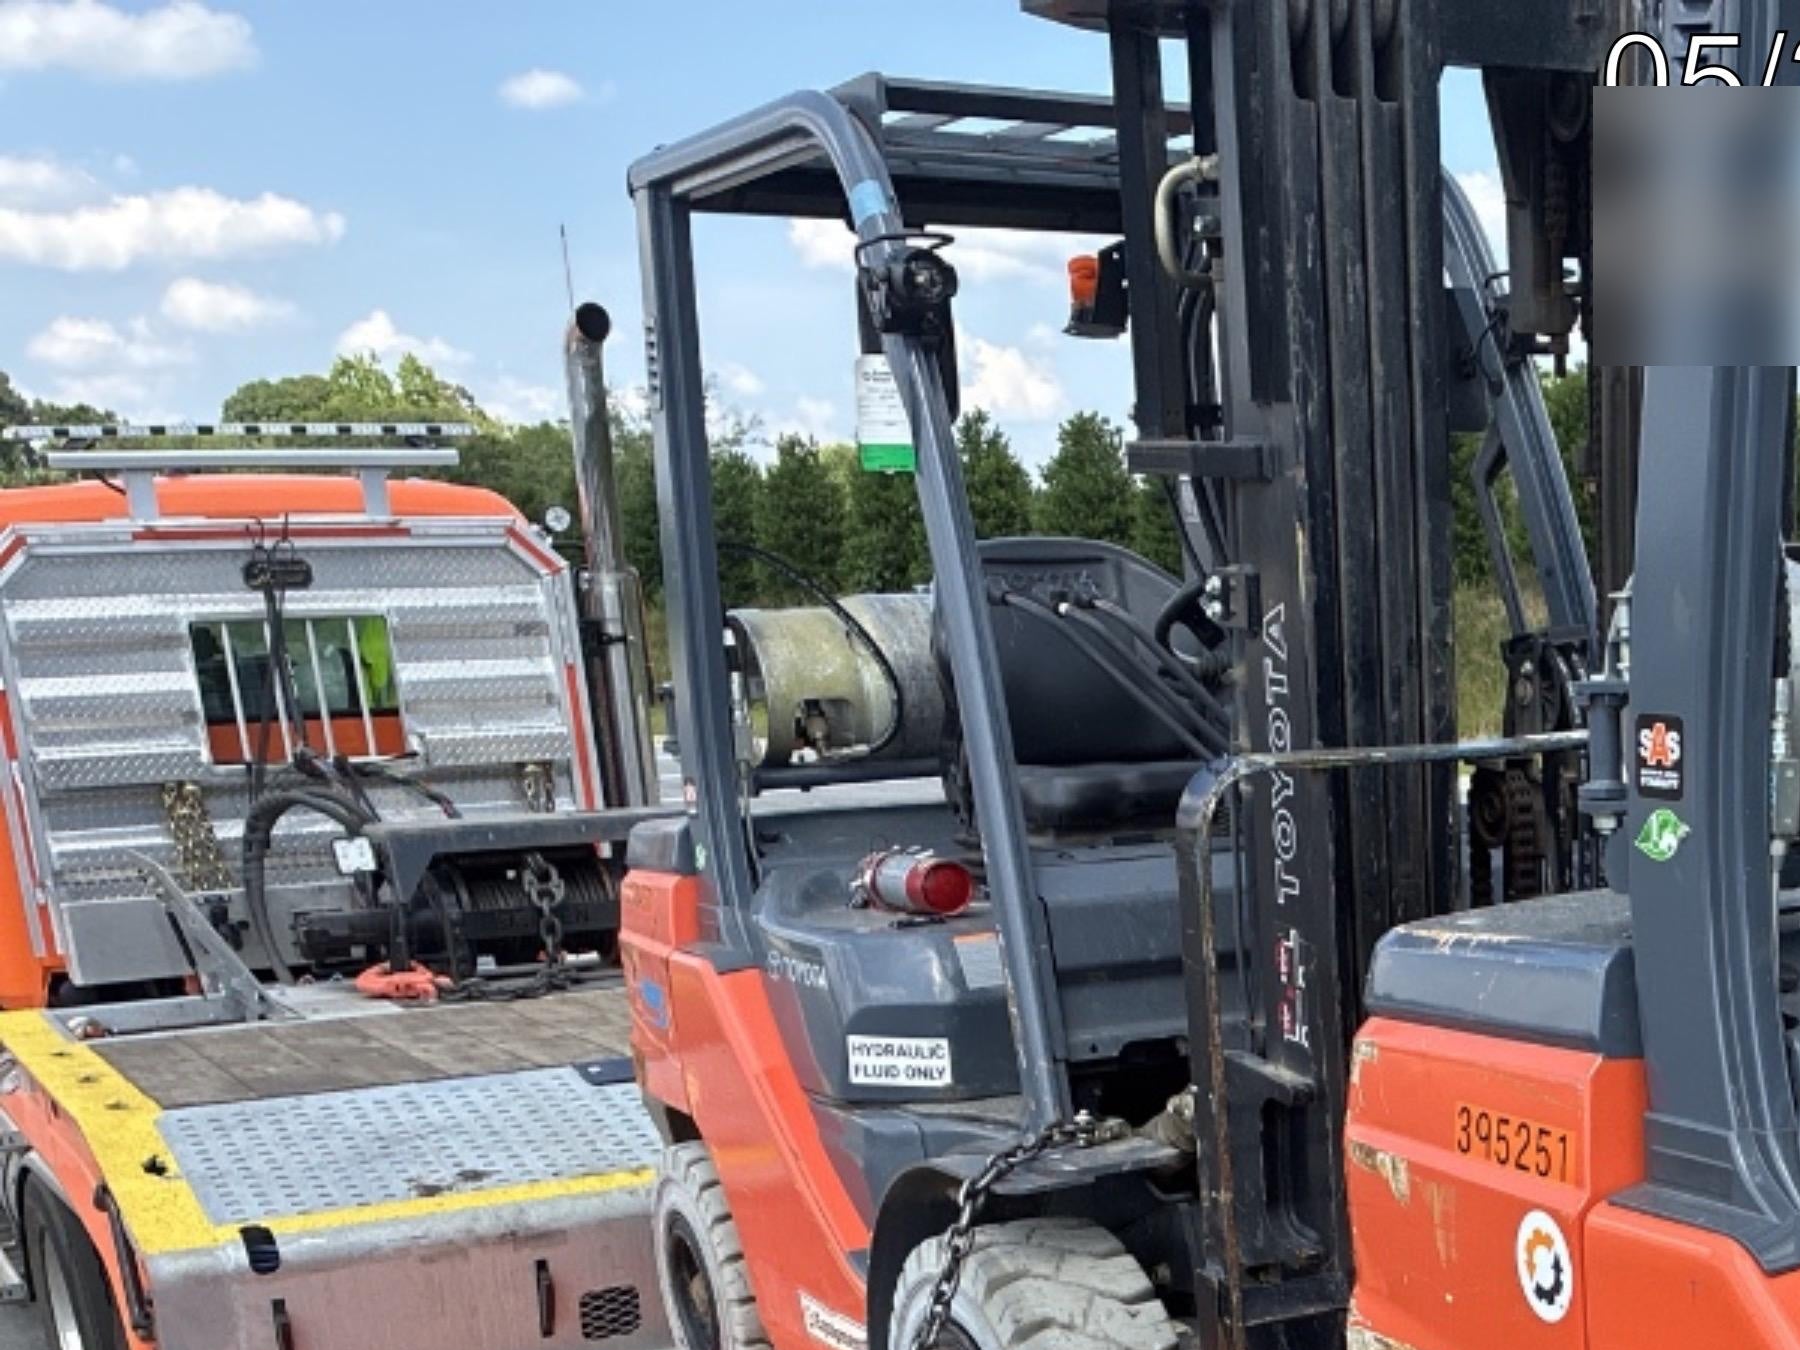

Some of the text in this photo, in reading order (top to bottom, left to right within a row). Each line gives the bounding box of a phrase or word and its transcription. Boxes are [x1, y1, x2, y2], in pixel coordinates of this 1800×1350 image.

[1262, 601, 1300, 904] TOYOTA
[851, 1043, 946, 1060] HYDRAULIC
[853, 1063, 946, 1081] FLUID ONLY
[1457, 1105, 1569, 1183] 395251
